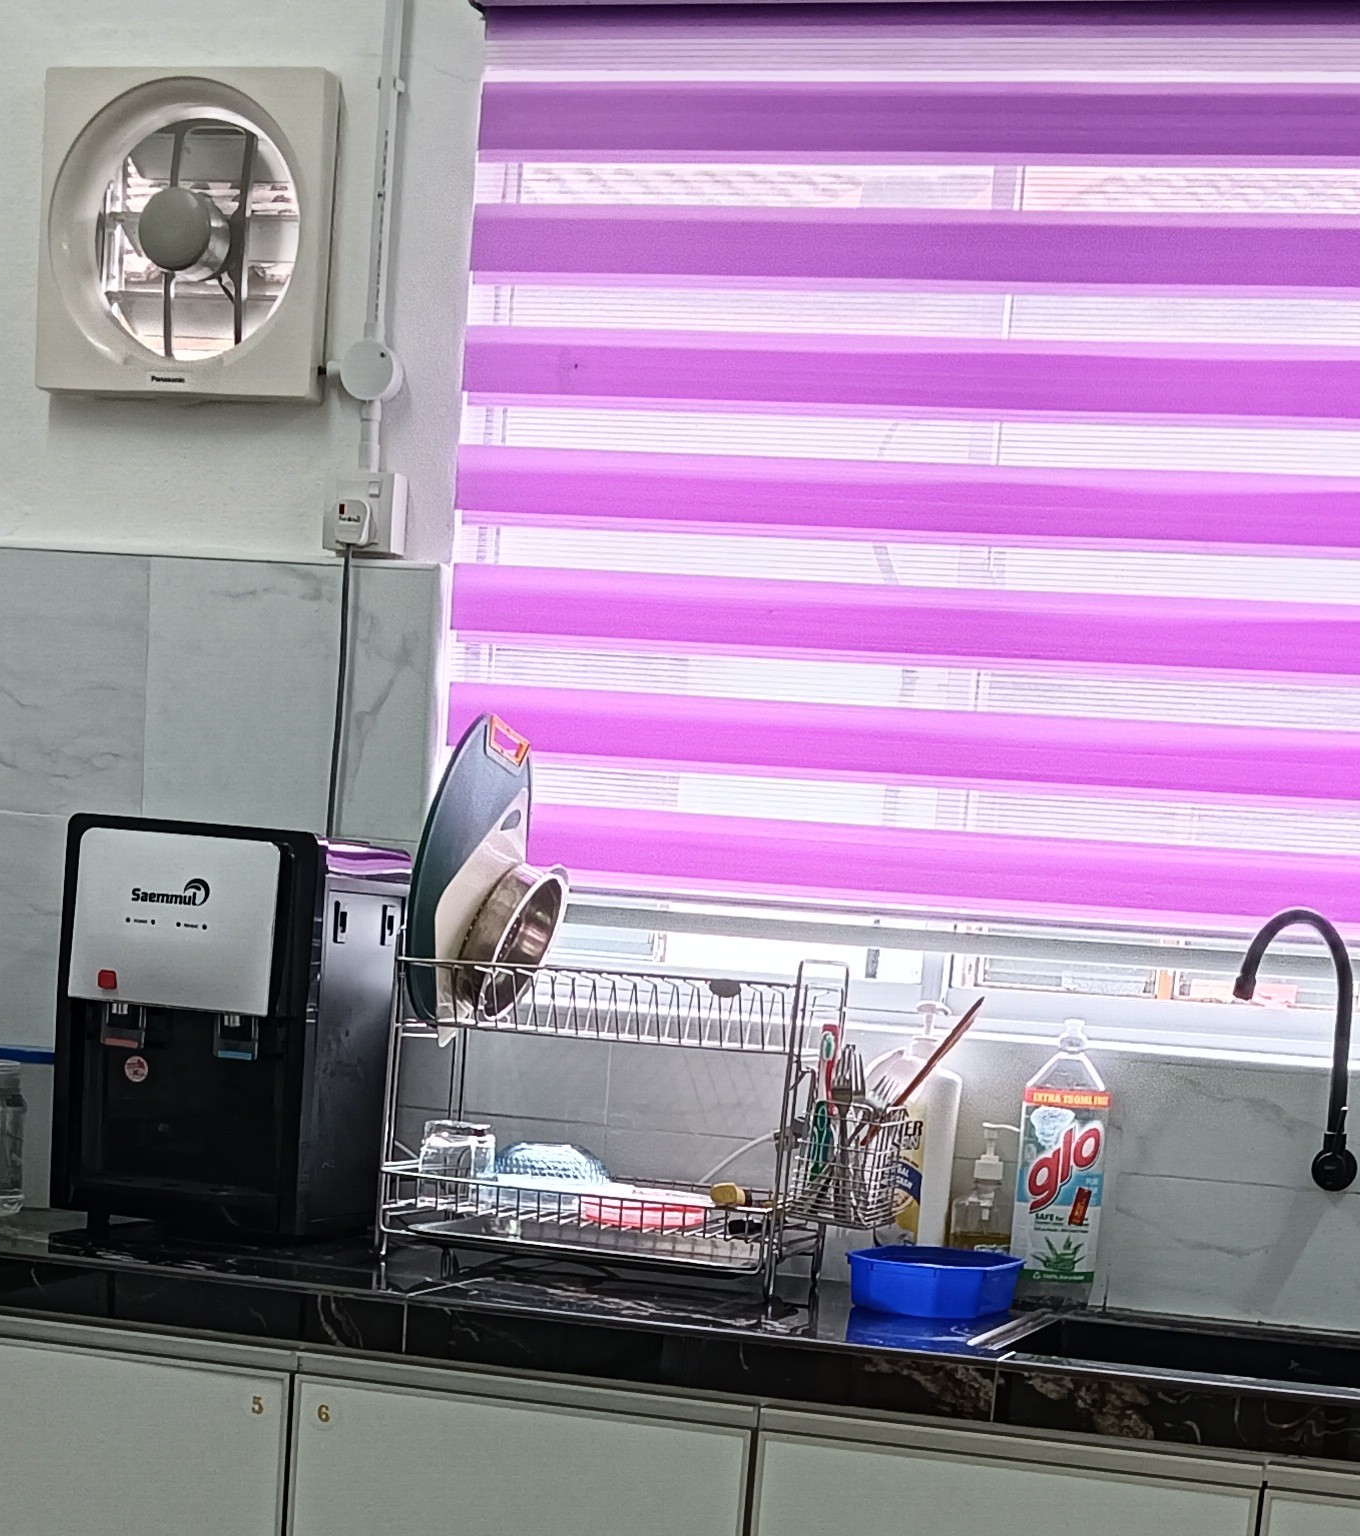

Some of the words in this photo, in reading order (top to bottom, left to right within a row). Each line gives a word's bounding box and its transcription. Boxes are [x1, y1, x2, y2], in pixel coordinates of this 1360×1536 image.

[151, 375, 186, 384] Panasonic
[131, 887, 199, 907] Saemmul
[1033, 1091, 1062, 1105] EXTRA
[1028, 1127, 1101, 1214] glo
[251, 1395, 264, 1415] 5
[317, 1404, 330, 1423] 6
